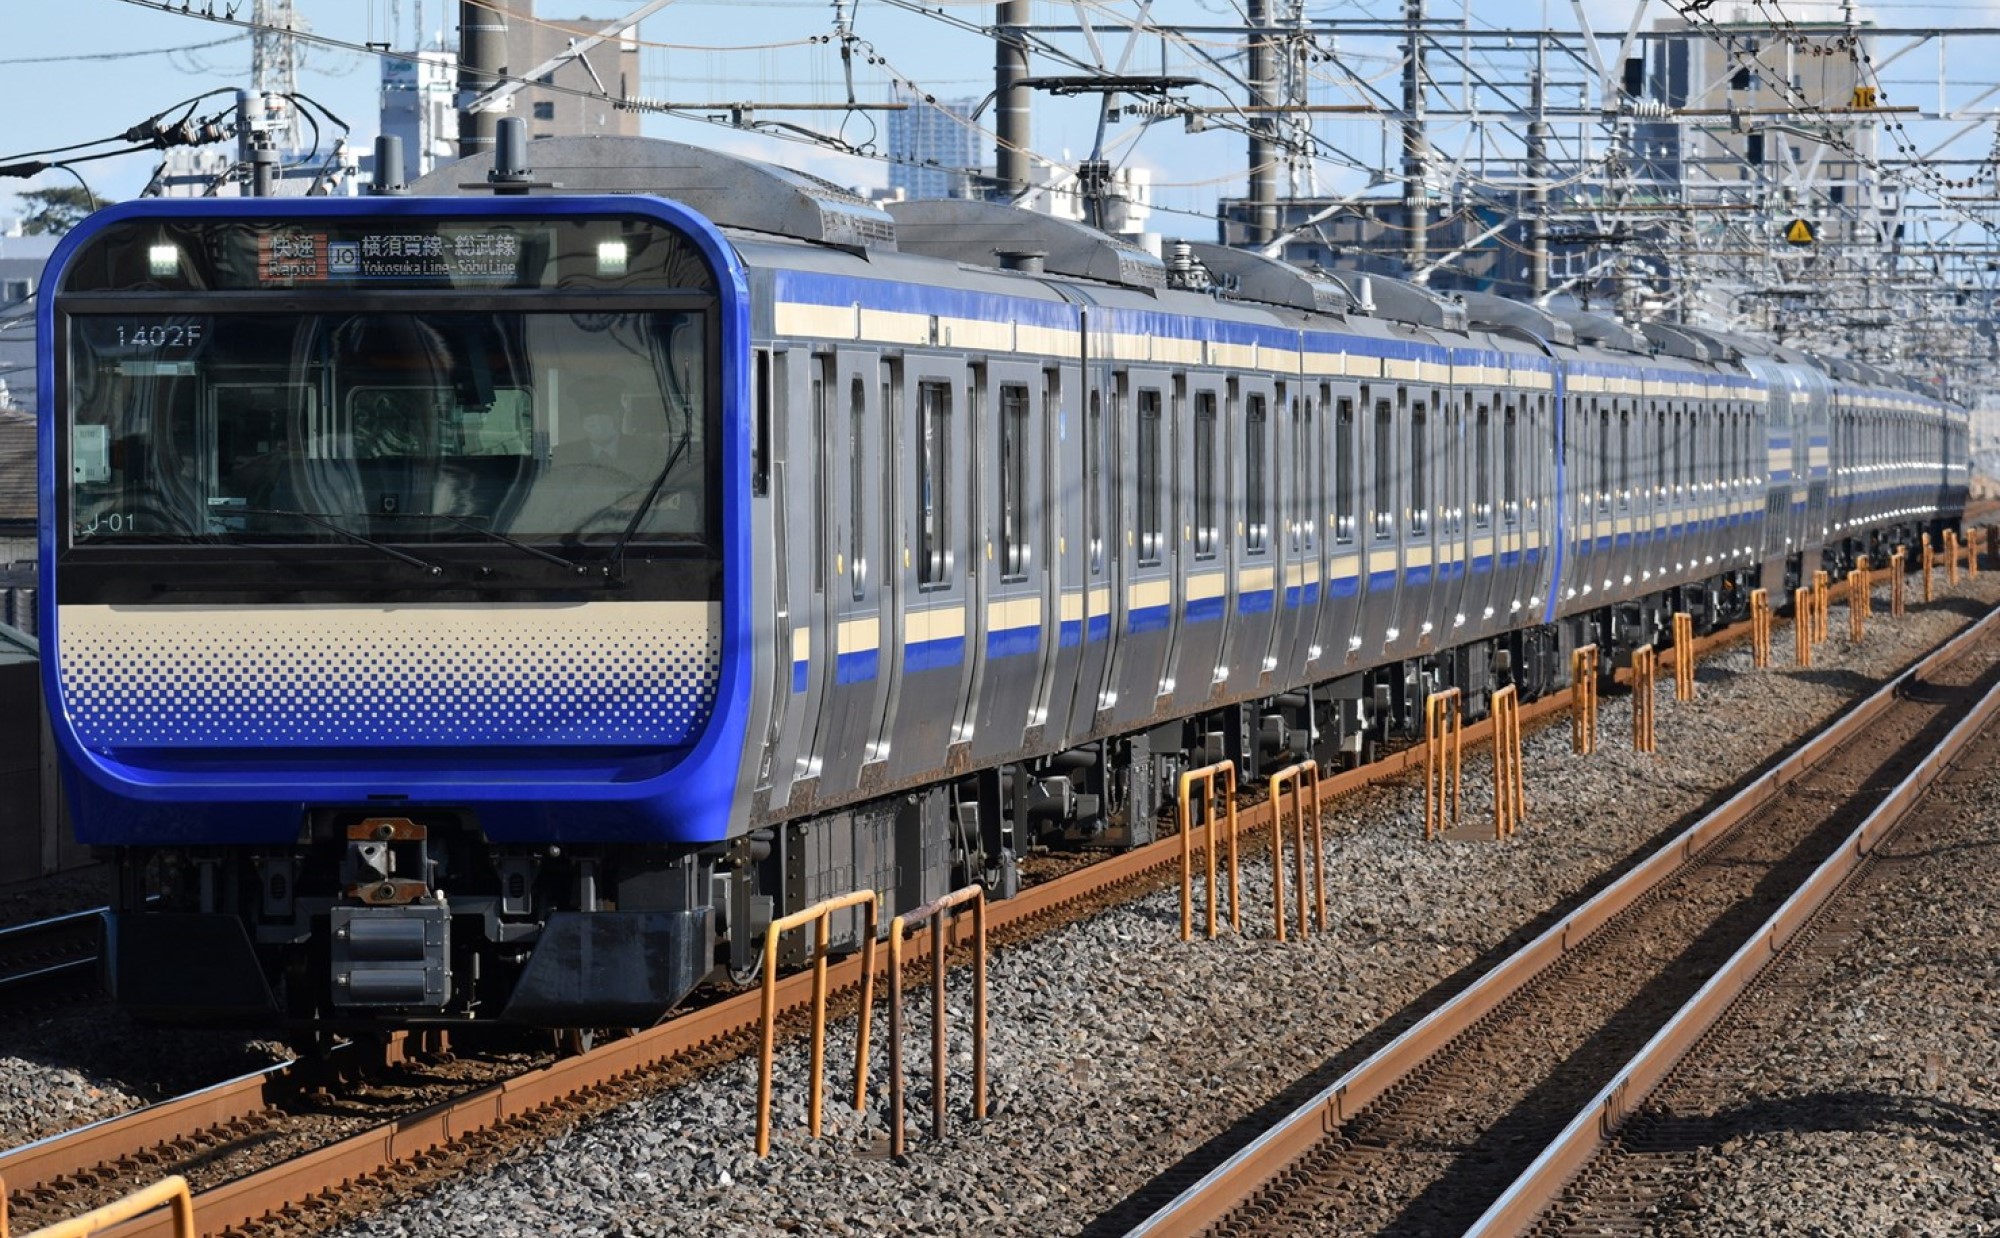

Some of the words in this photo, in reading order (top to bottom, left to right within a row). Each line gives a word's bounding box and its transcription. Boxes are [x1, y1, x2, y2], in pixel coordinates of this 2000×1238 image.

[270, 235, 314, 257] 快速
[334, 247, 354, 264] JO
[269, 261, 316, 275] Rapid
[362, 261, 420, 275] Yokosuka
[489, 260, 515, 275] Line
[116, 325, 201, 347] 1402F
[87, 512, 134, 532] J-01
